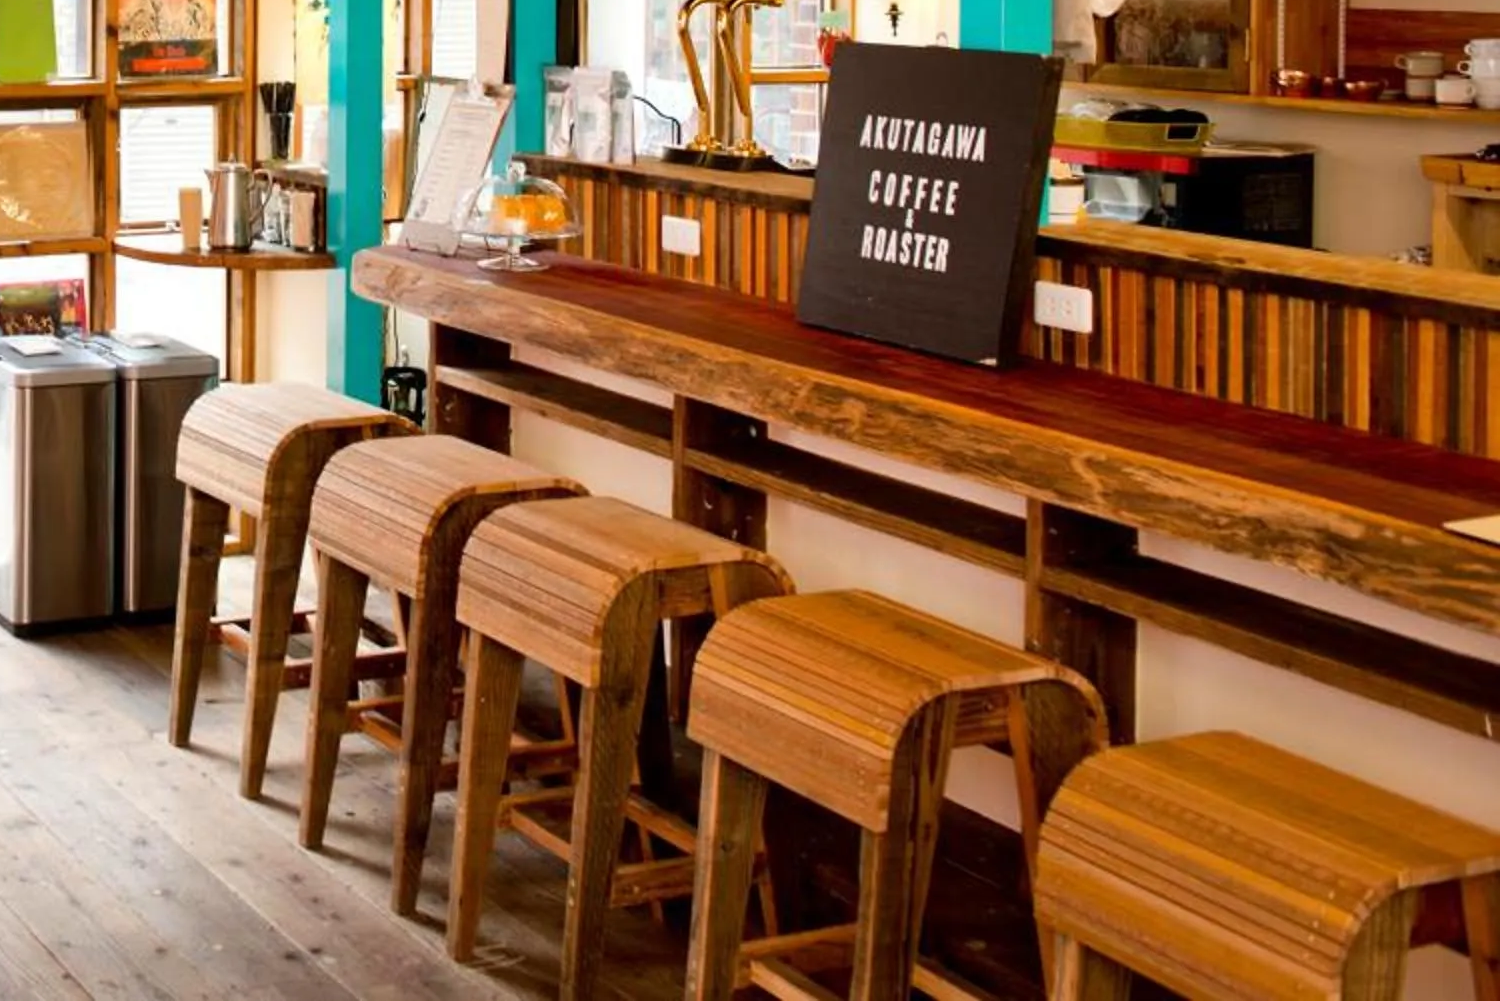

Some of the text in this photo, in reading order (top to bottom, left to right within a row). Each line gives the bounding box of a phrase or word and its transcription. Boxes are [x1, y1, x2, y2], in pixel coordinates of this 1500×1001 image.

[860, 114, 987, 162] AKUTAGAWA
[868, 170, 959, 215] COFFEE
[905, 208, 914, 229] &
[861, 224, 950, 272] ROASTER
